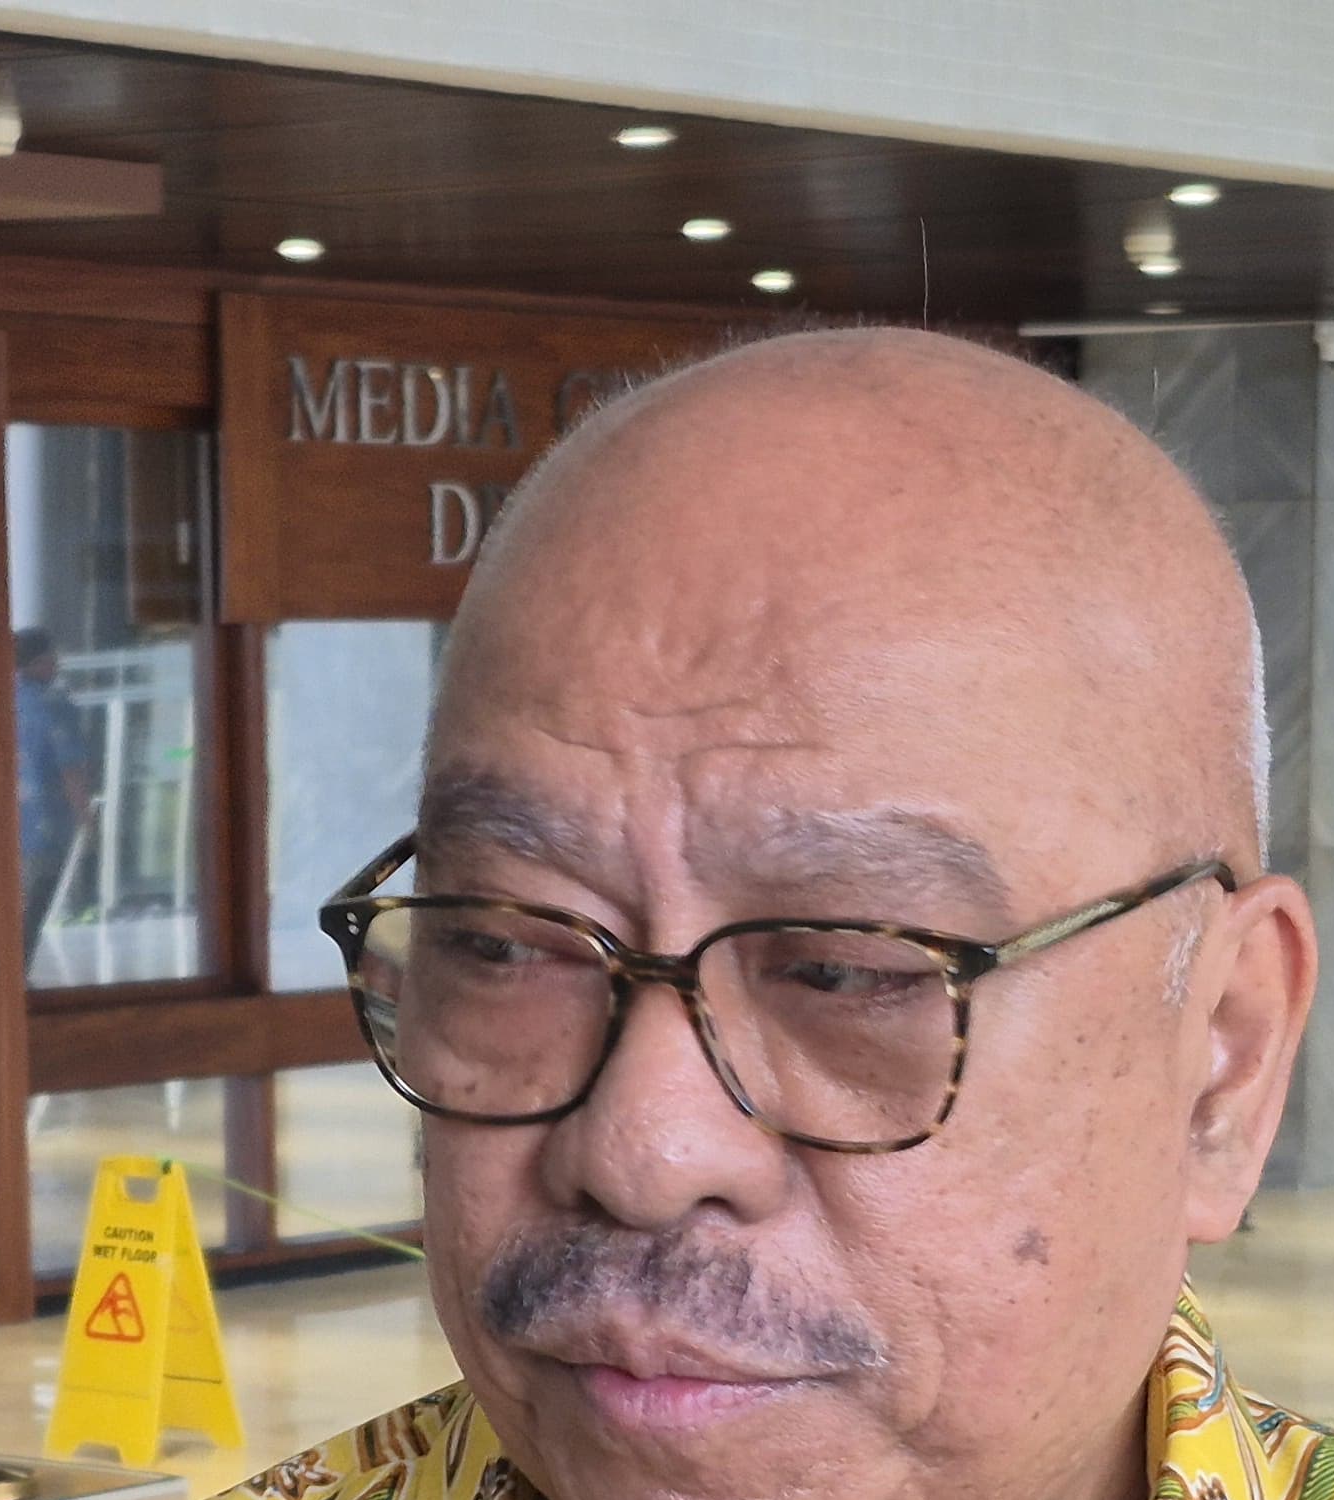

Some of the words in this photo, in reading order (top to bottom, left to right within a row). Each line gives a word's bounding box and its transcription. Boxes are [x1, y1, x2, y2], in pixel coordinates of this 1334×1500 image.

[286, 355, 523, 448] MEDIA
[103, 1226, 155, 1243] CAUTION
[93, 1245, 117, 1259] WET
[121, 1247, 157, 1264] FLOOR
